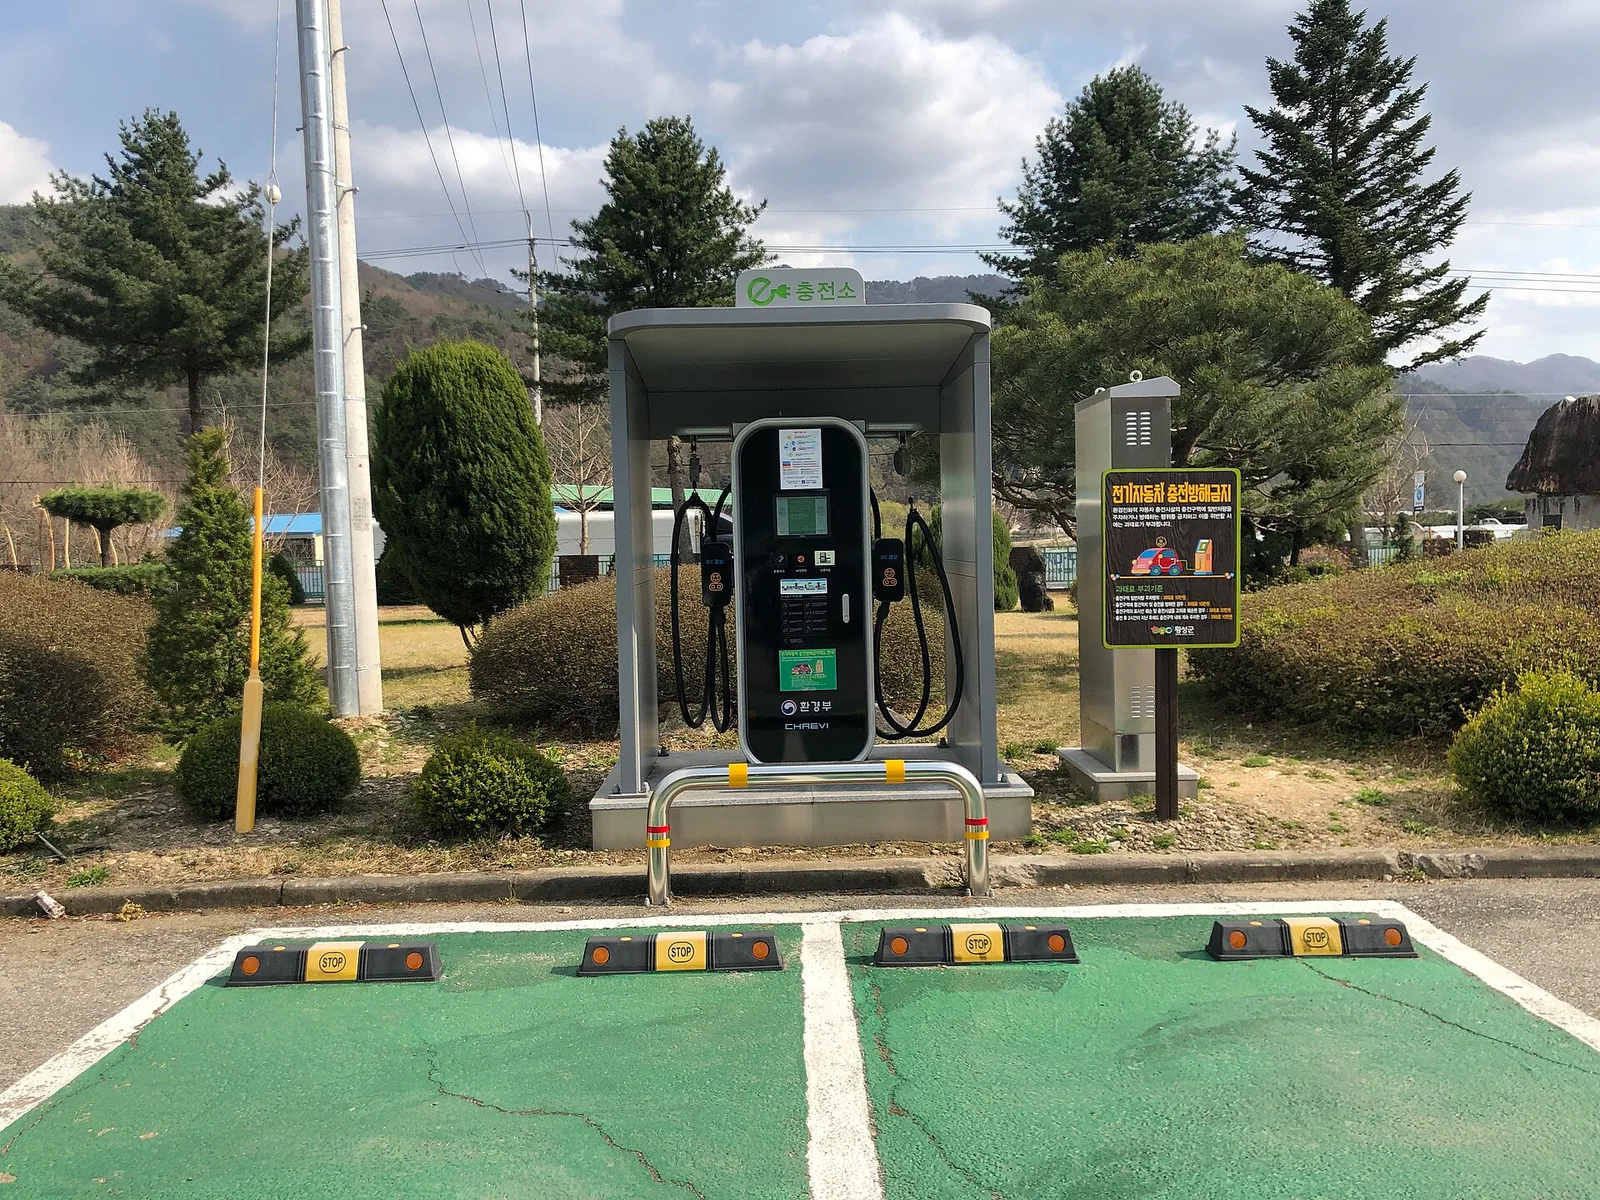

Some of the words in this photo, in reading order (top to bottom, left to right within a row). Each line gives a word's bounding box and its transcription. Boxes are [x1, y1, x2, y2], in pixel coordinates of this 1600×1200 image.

[796, 281, 856, 302] 충전소
[1112, 482, 1165, 504] 전기자동차
[1167, 481, 1232, 503] 충전방해금지
[1116, 585, 1136, 593] 과태료
[1137, 585, 1164, 593] 부과기준
[1174, 626, 1194, 634] 횡성군
[800, 700, 832, 712] 환경부
[1306, 932, 1326, 943] STOP
[968, 939, 988, 950] STOP
[671, 946, 692, 958] STOP
[322, 954, 343, 968] STOP
